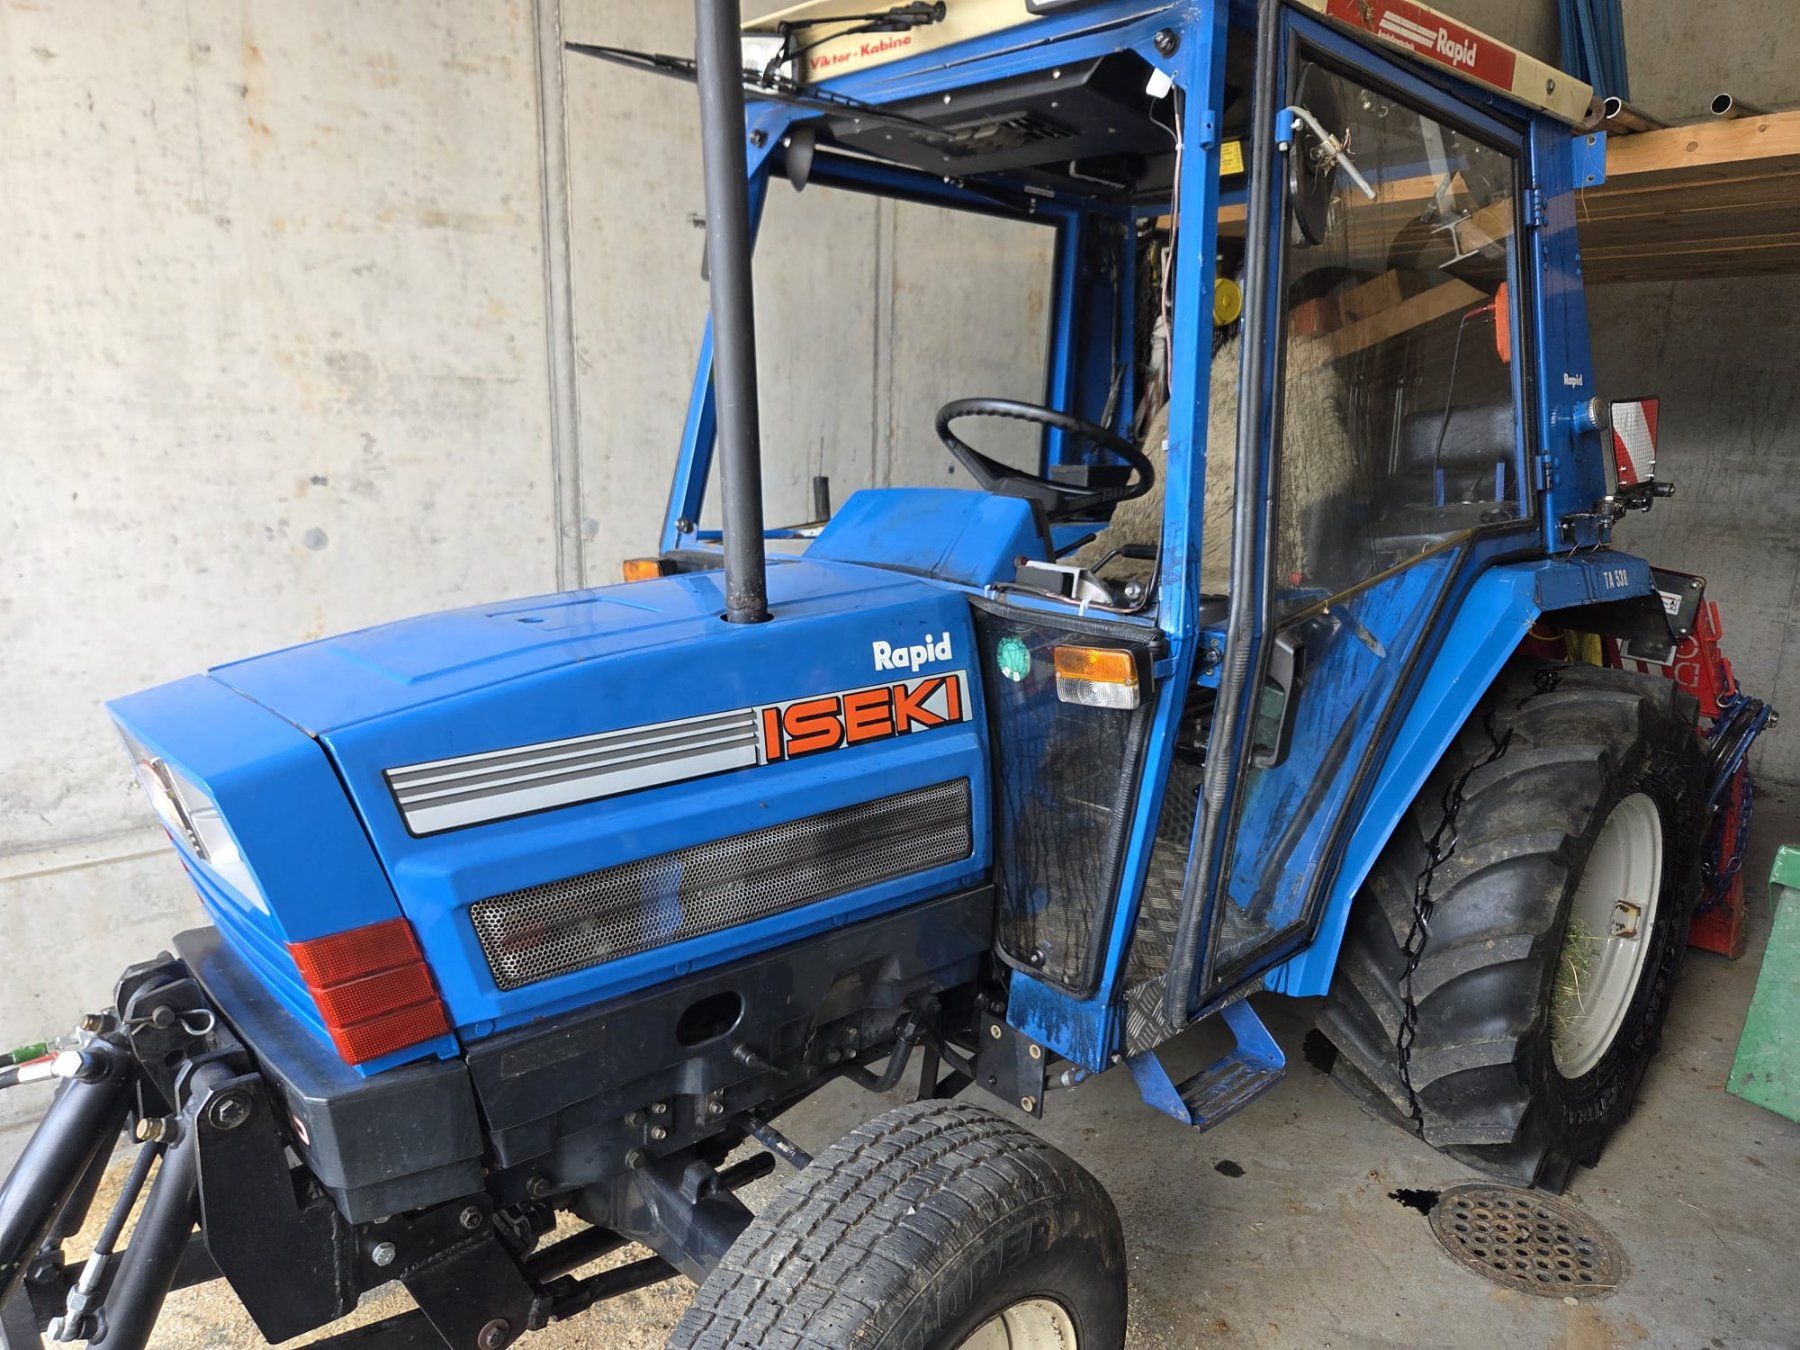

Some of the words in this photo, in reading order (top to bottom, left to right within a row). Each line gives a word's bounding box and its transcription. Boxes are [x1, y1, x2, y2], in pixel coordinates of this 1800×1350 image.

[1437, 27, 1478, 67] Rapid
[1563, 372, 1583, 389] Rapid
[1603, 571, 1615, 590] TA
[872, 632, 952, 672] Rapid
[762, 674, 962, 762] ISEKI
